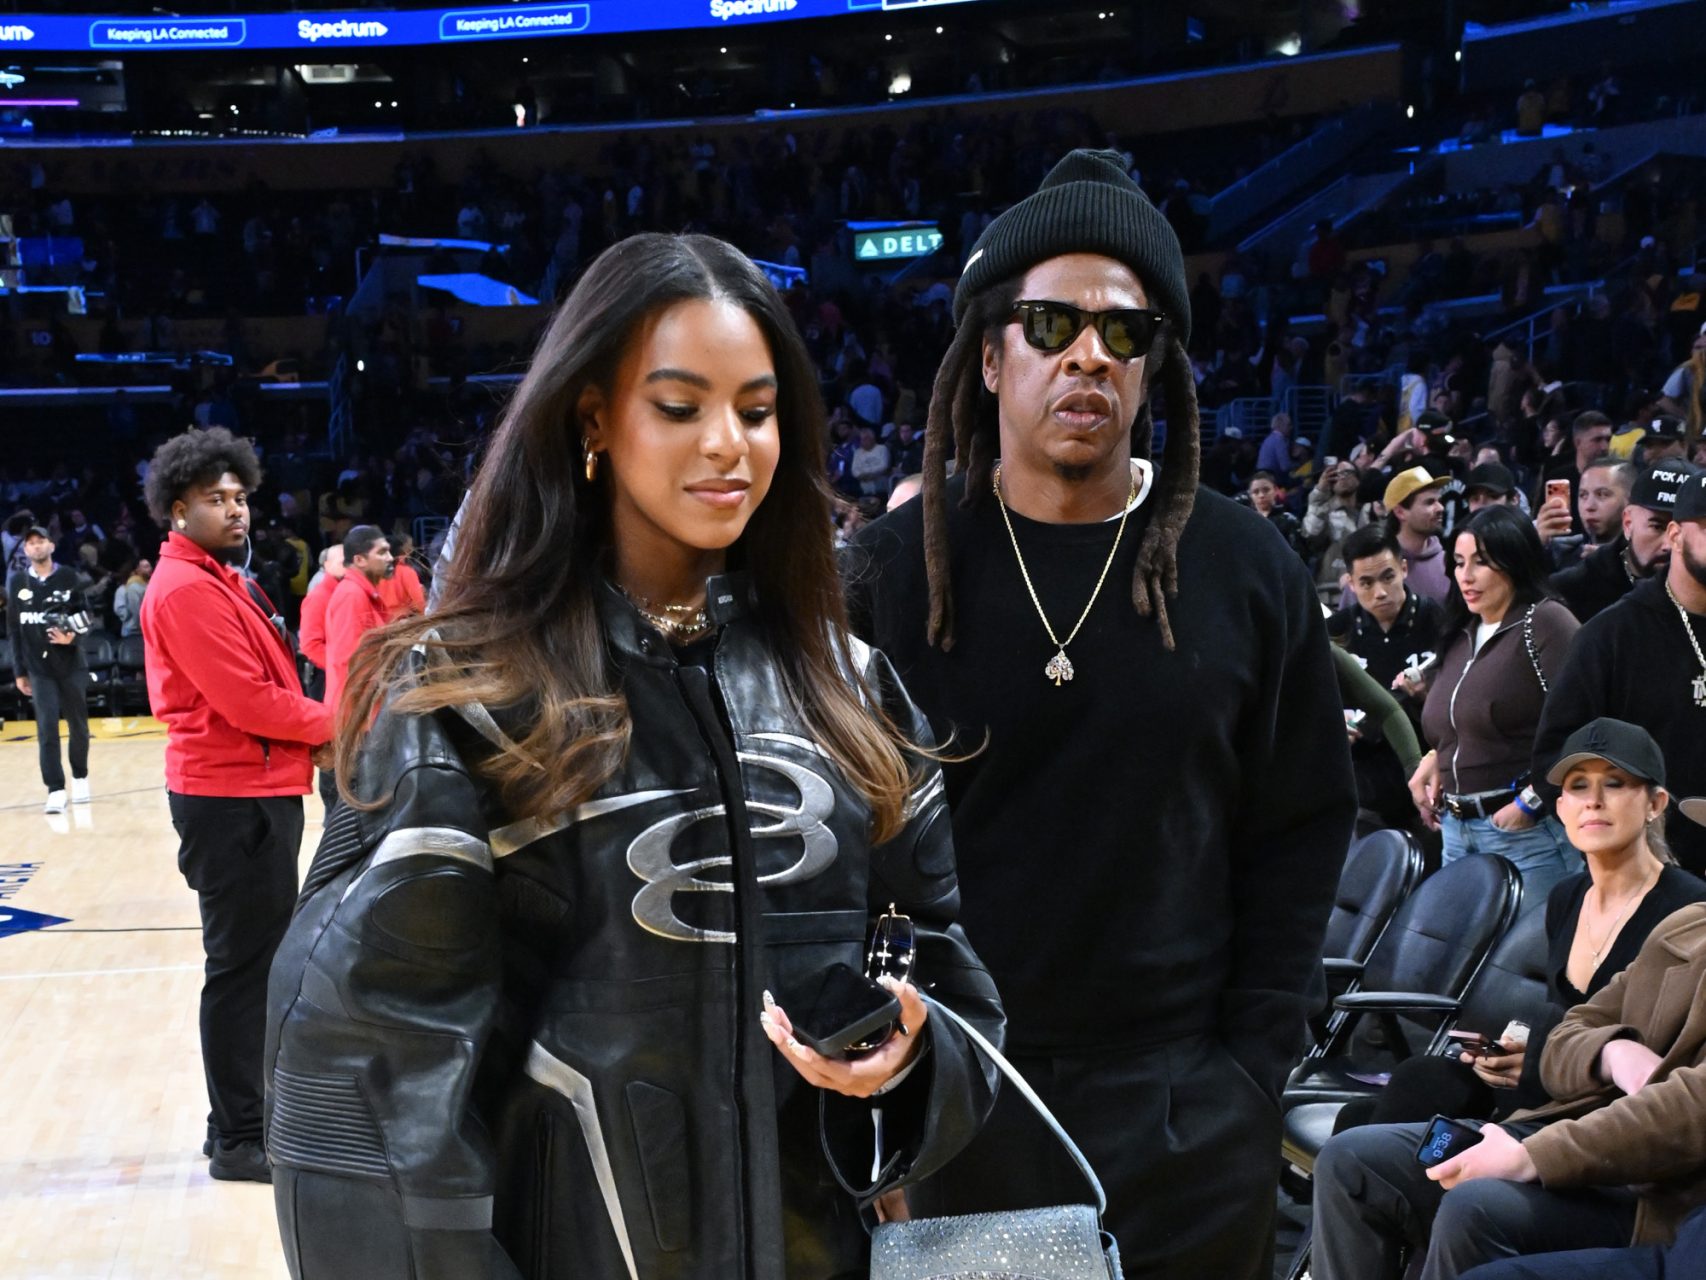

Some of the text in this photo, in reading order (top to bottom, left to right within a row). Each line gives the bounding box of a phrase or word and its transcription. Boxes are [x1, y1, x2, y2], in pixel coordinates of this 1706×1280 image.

[298, 19, 382, 42] Spectrum
[457, 12, 573, 32] Keeping LA Connected
[107, 26, 229, 43] Keeping LA Connected
